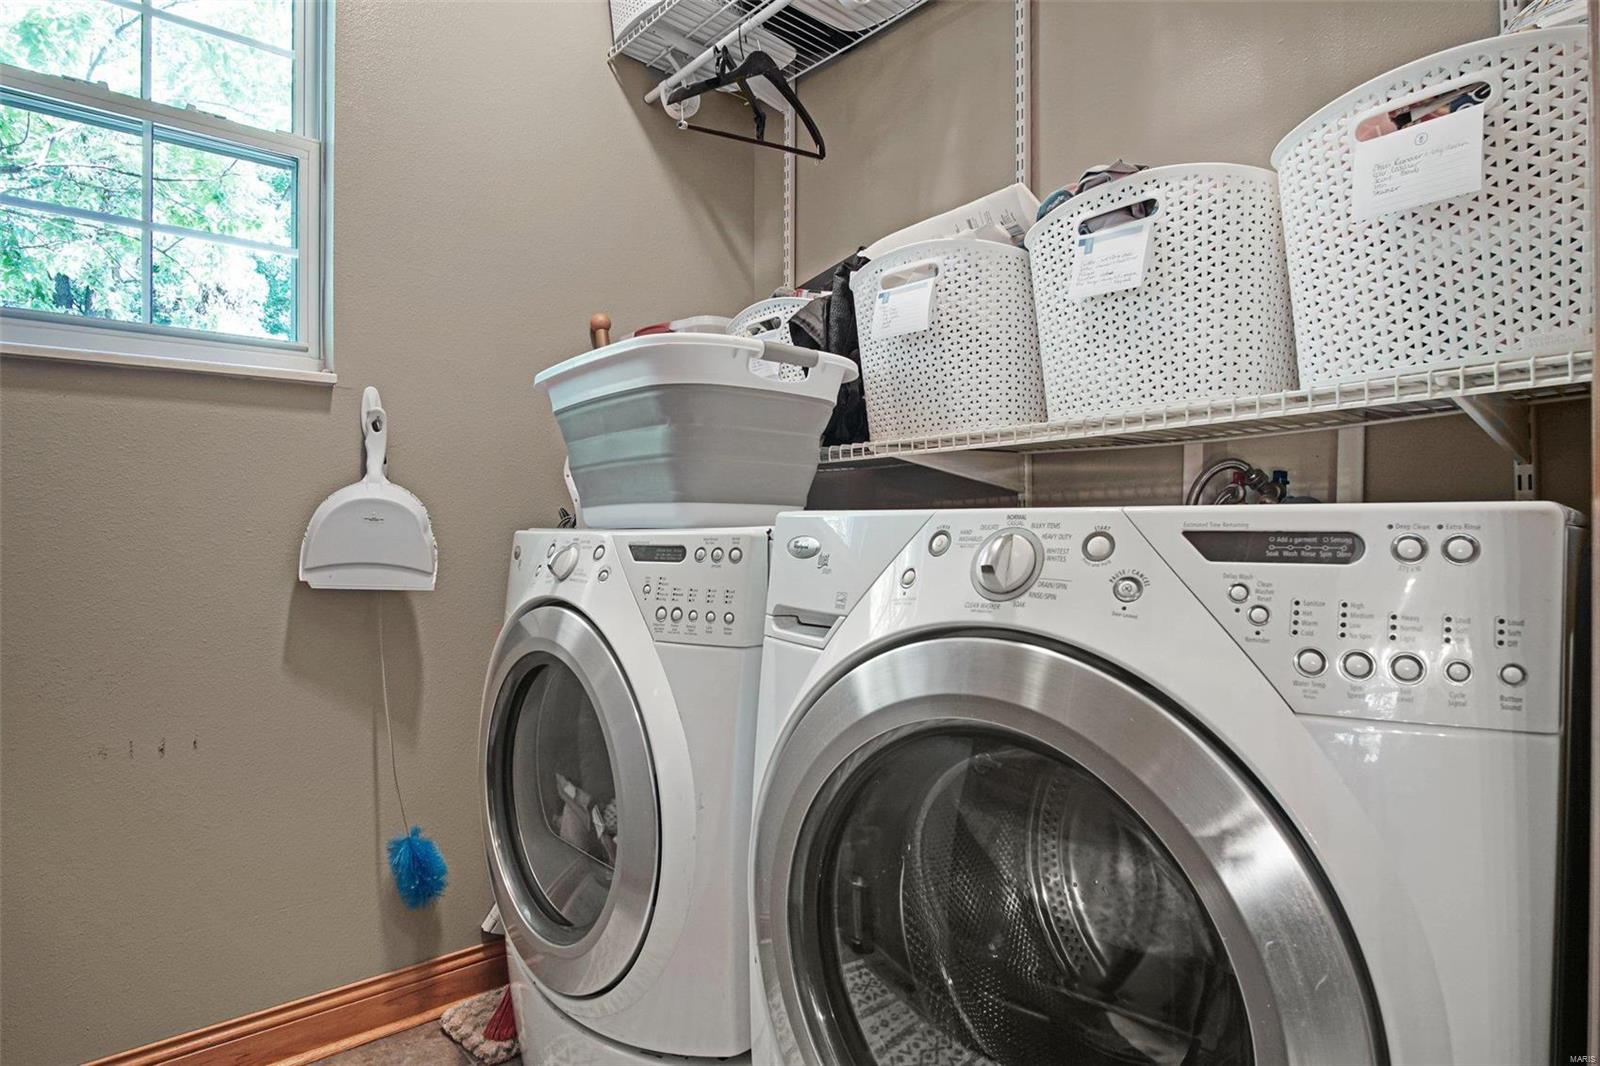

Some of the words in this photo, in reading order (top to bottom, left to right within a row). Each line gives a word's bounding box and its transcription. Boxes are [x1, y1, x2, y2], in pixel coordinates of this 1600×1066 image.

[1294, 537, 1318, 545] garment
[1319, 551, 1333, 559] Spin
[1108, 569, 1126, 583] PAUSE
[1131, 569, 1151, 587] CANCEL
[1507, 640, 1519, 648] Off
[1312, 681, 1327, 689] Temp
[1449, 691, 1466, 699] Cycle
